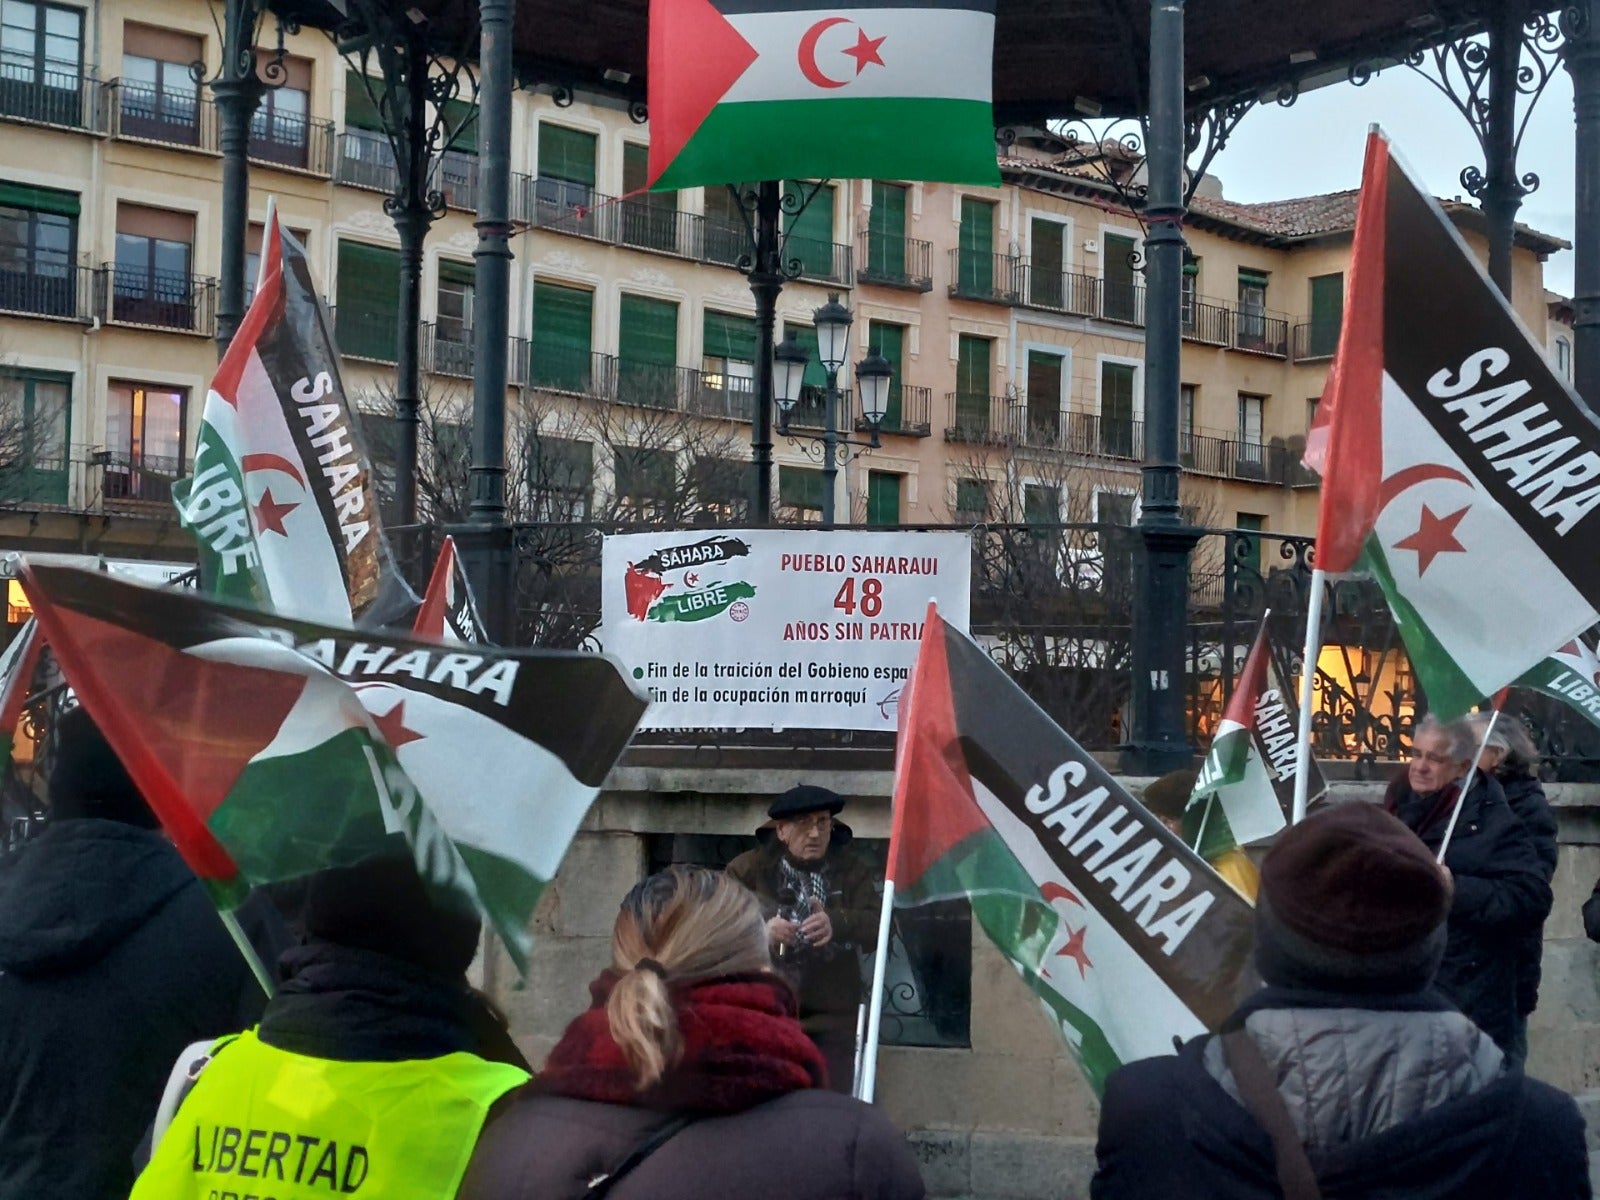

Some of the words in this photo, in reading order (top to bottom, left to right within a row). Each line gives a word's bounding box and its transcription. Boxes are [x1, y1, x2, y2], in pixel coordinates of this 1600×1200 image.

[1426, 347, 1600, 536] SAHARA
[290, 371, 370, 554] SAHARA
[661, 545, 724, 567] SÁHARA
[781, 554, 845, 573] PUEBLO
[852, 556, 938, 575] SAHARAUI
[678, 589, 728, 613] LIBRE
[834, 577, 882, 617] 48
[783, 621, 829, 640] AÑOS
[835, 623, 863, 640] SIN
[648, 662, 667, 678] Fin
[672, 662, 689, 678] de
[695, 662, 708, 677] la
[714, 662, 772, 678] traición
[779, 662, 801, 678] del
[808, 662, 869, 679] Gobieno
[874, 666, 911, 683] espa
[672, 687, 689, 702] de
[695, 687, 707, 702] la
[713, 687, 789, 705] ocupación
[795, 688, 867, 707] marroquí
[1547, 671, 1600, 720] LIBR
[1253, 689, 1299, 782] SAHARA
[1025, 760, 1216, 956] SAHARA
[192, 1125, 369, 1194] LIBERTAD
